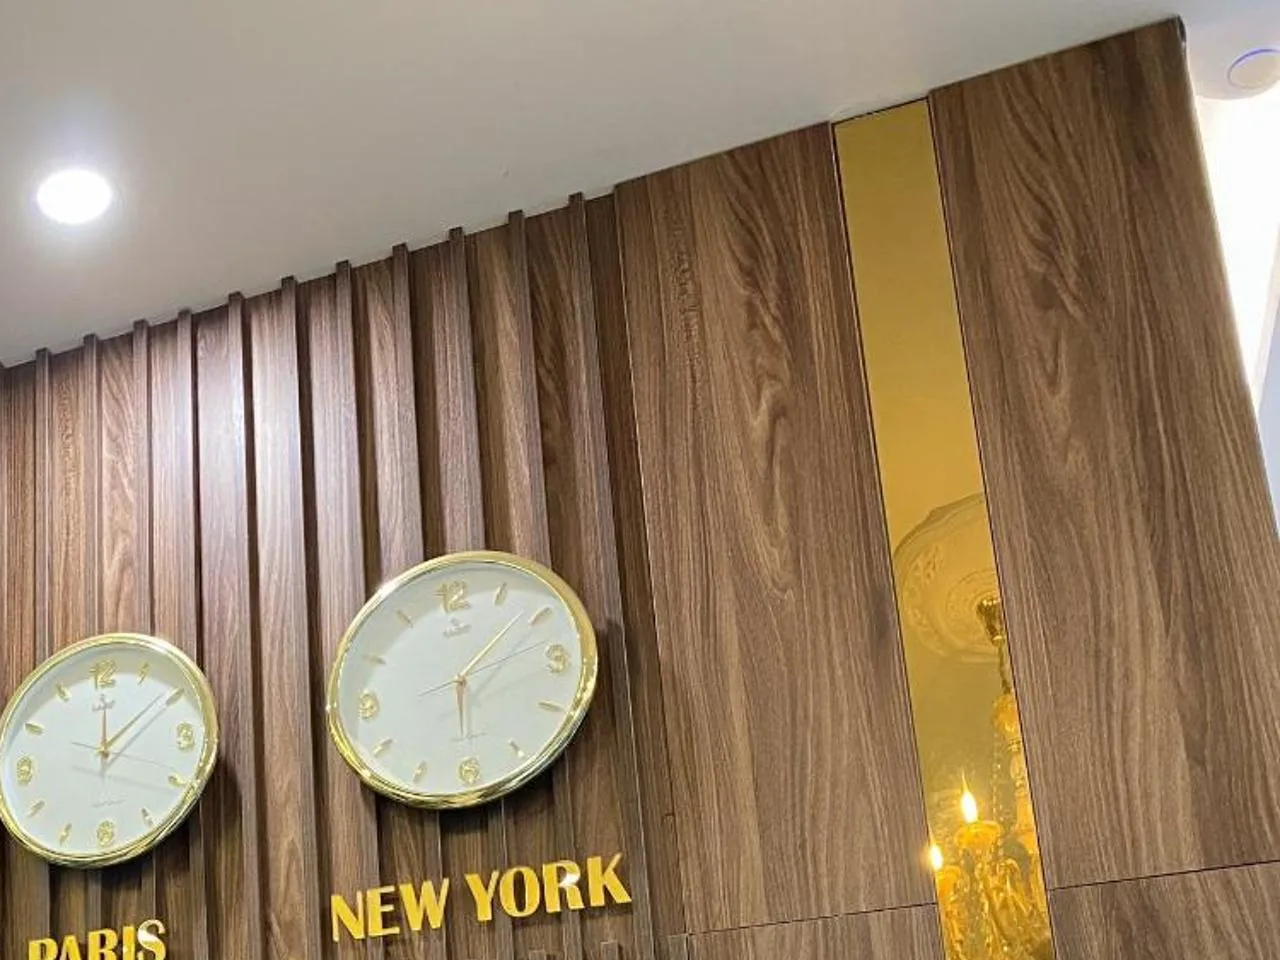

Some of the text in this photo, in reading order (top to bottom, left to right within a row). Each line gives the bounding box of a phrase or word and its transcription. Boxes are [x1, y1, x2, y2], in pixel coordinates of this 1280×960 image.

[438, 581, 470, 612] 12
[90, 660, 116, 688] 12
[546, 645, 570, 674] 3
[358, 689, 379, 719] 9
[177, 722, 195, 751] 3
[16, 756, 33, 785] 9
[460, 756, 481, 784] 6
[97, 820, 115, 846] 6
[330, 853, 632, 942] NEW YORK
